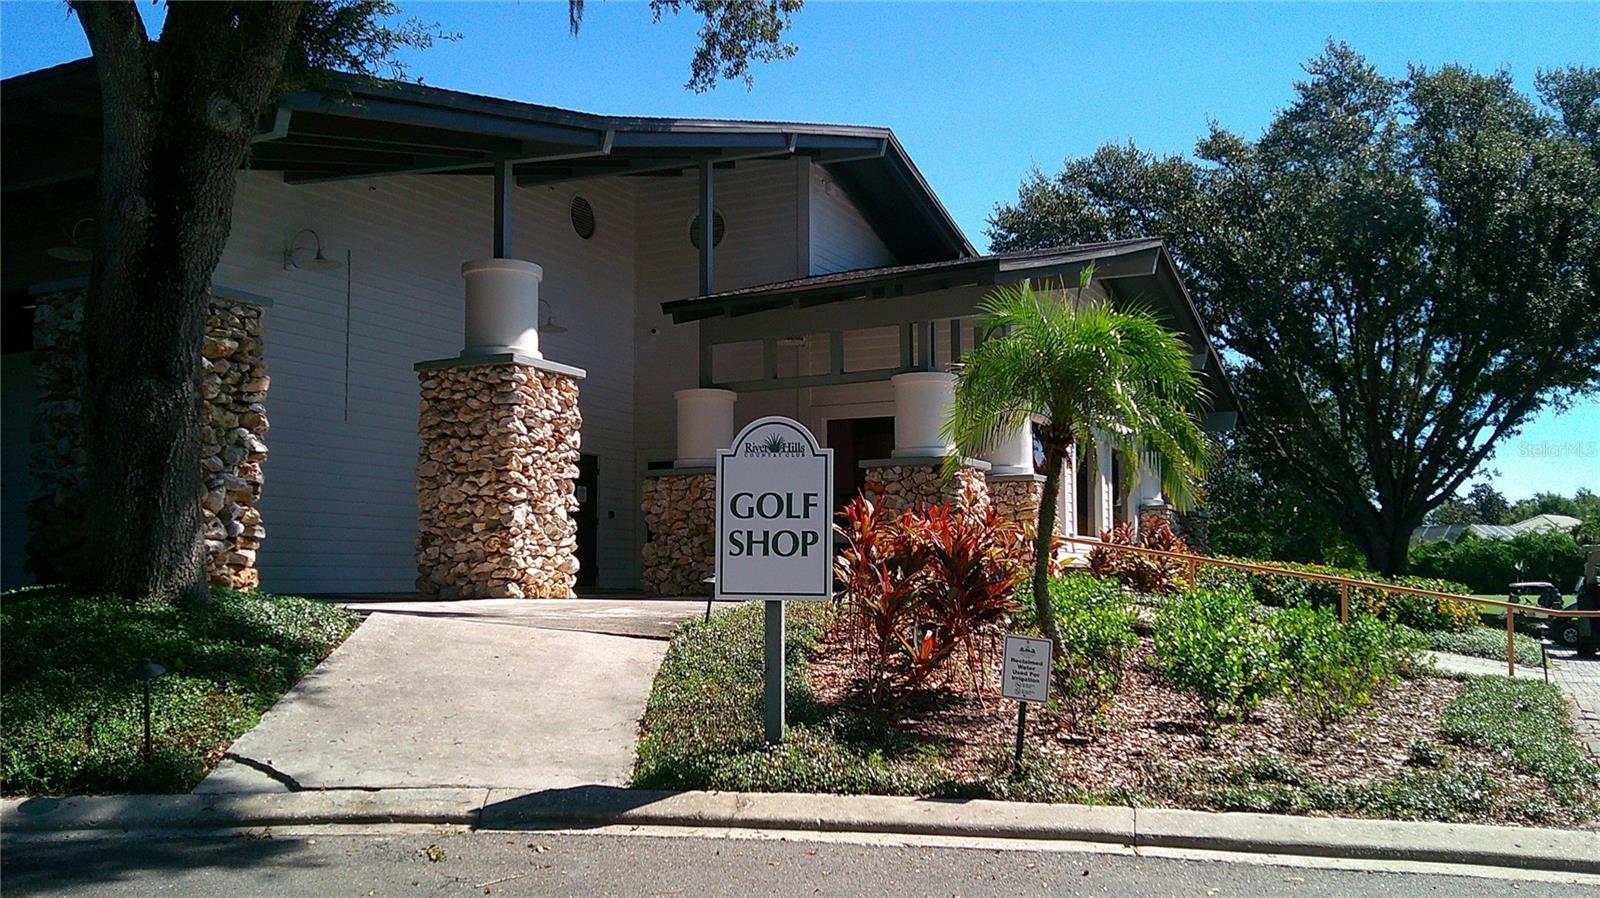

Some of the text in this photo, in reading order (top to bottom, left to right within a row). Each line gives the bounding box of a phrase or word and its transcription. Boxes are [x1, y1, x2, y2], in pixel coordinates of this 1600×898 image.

[744, 442, 805, 453] River Hills
[729, 492, 818, 519] GOLF
[728, 530, 819, 557] SHOP
[1010, 657, 1043, 665] Reclaimed
[1011, 675, 1040, 683] Irrigation
